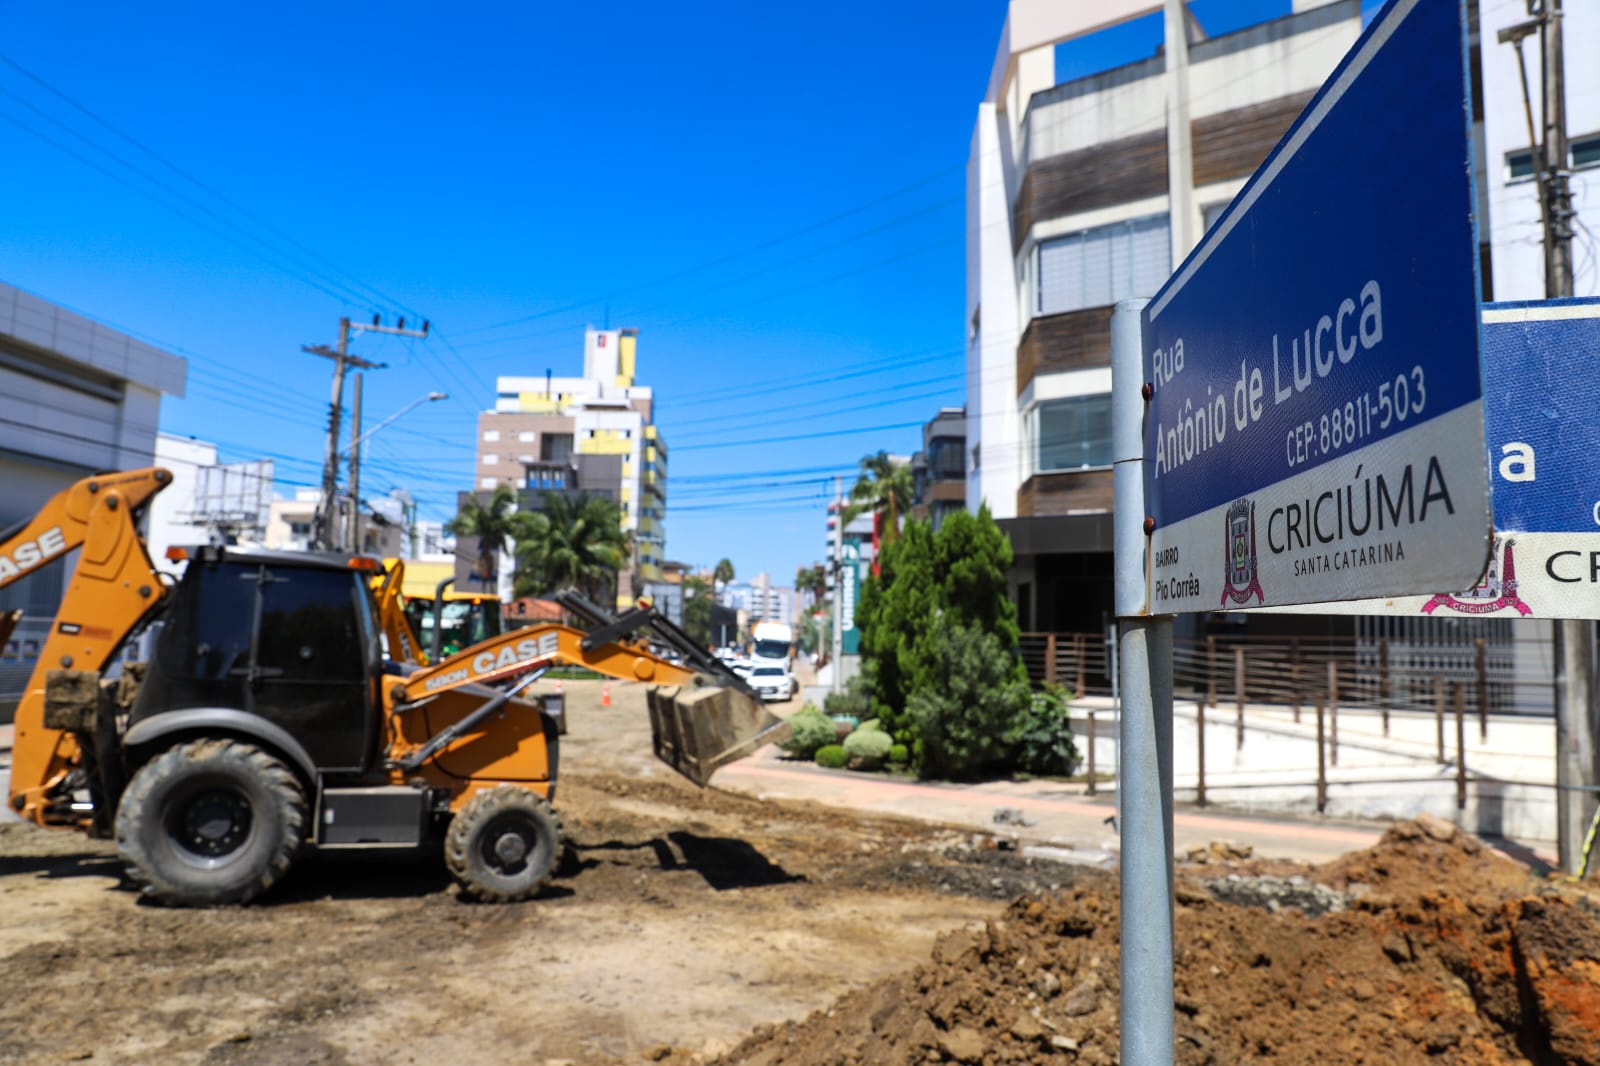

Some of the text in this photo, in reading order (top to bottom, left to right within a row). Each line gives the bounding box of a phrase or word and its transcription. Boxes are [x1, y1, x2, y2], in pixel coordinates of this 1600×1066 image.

[1153, 338, 1184, 392] Rua
[1155, 280, 1383, 479] Antônio de Lucca
[1267, 456, 1455, 554] CRICIÚMA
[1155, 546, 1179, 568] BAIRRO
[1294, 540, 1405, 577] SANTA CATARINA
[1170, 572, 1200, 600] Corrêa
[472, 632, 558, 674] CASE
